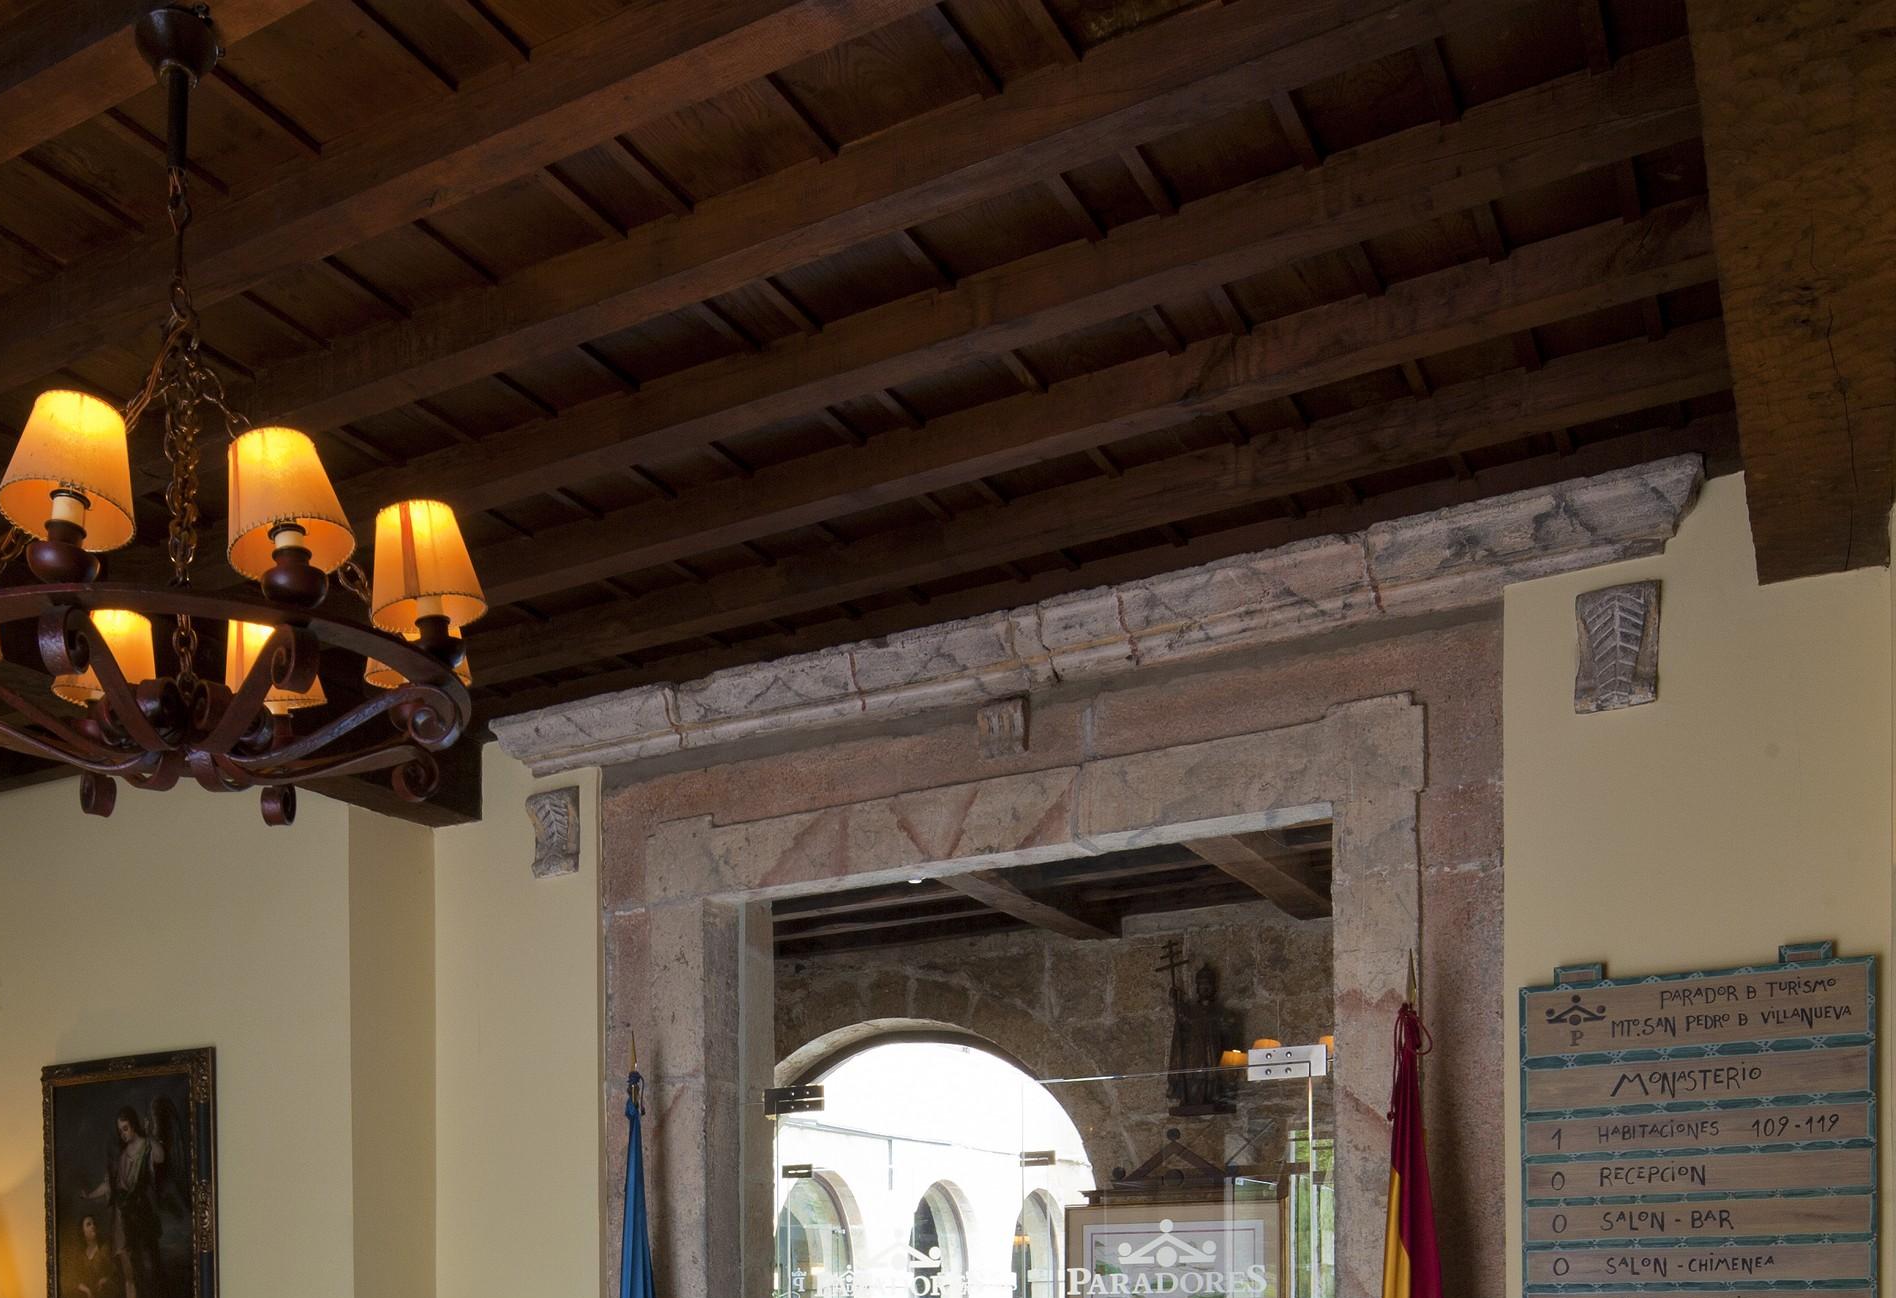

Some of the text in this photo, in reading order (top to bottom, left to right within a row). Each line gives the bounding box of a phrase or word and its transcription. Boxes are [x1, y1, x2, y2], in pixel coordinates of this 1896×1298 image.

[1660, 985, 1737, 1009] PARADOR
[1766, 977, 1836, 997] TURISMO
[1686, 1014, 1730, 1032] PEDRO
[1761, 1006, 1851, 1028] VILLANUEVA
[1610, 1062, 1761, 1098] MONASTERIO
[1552, 1114, 1839, 1150] 1 HABITACIONES 109-119
[1600, 1161, 1705, 1187] RECEPCION
[1601, 1211, 1664, 1232] SALON
[1691, 1210, 1734, 1229] BAR
[1066, 1264, 1267, 1296] PARADORES
[1606, 1257, 1666, 1277] SALON
